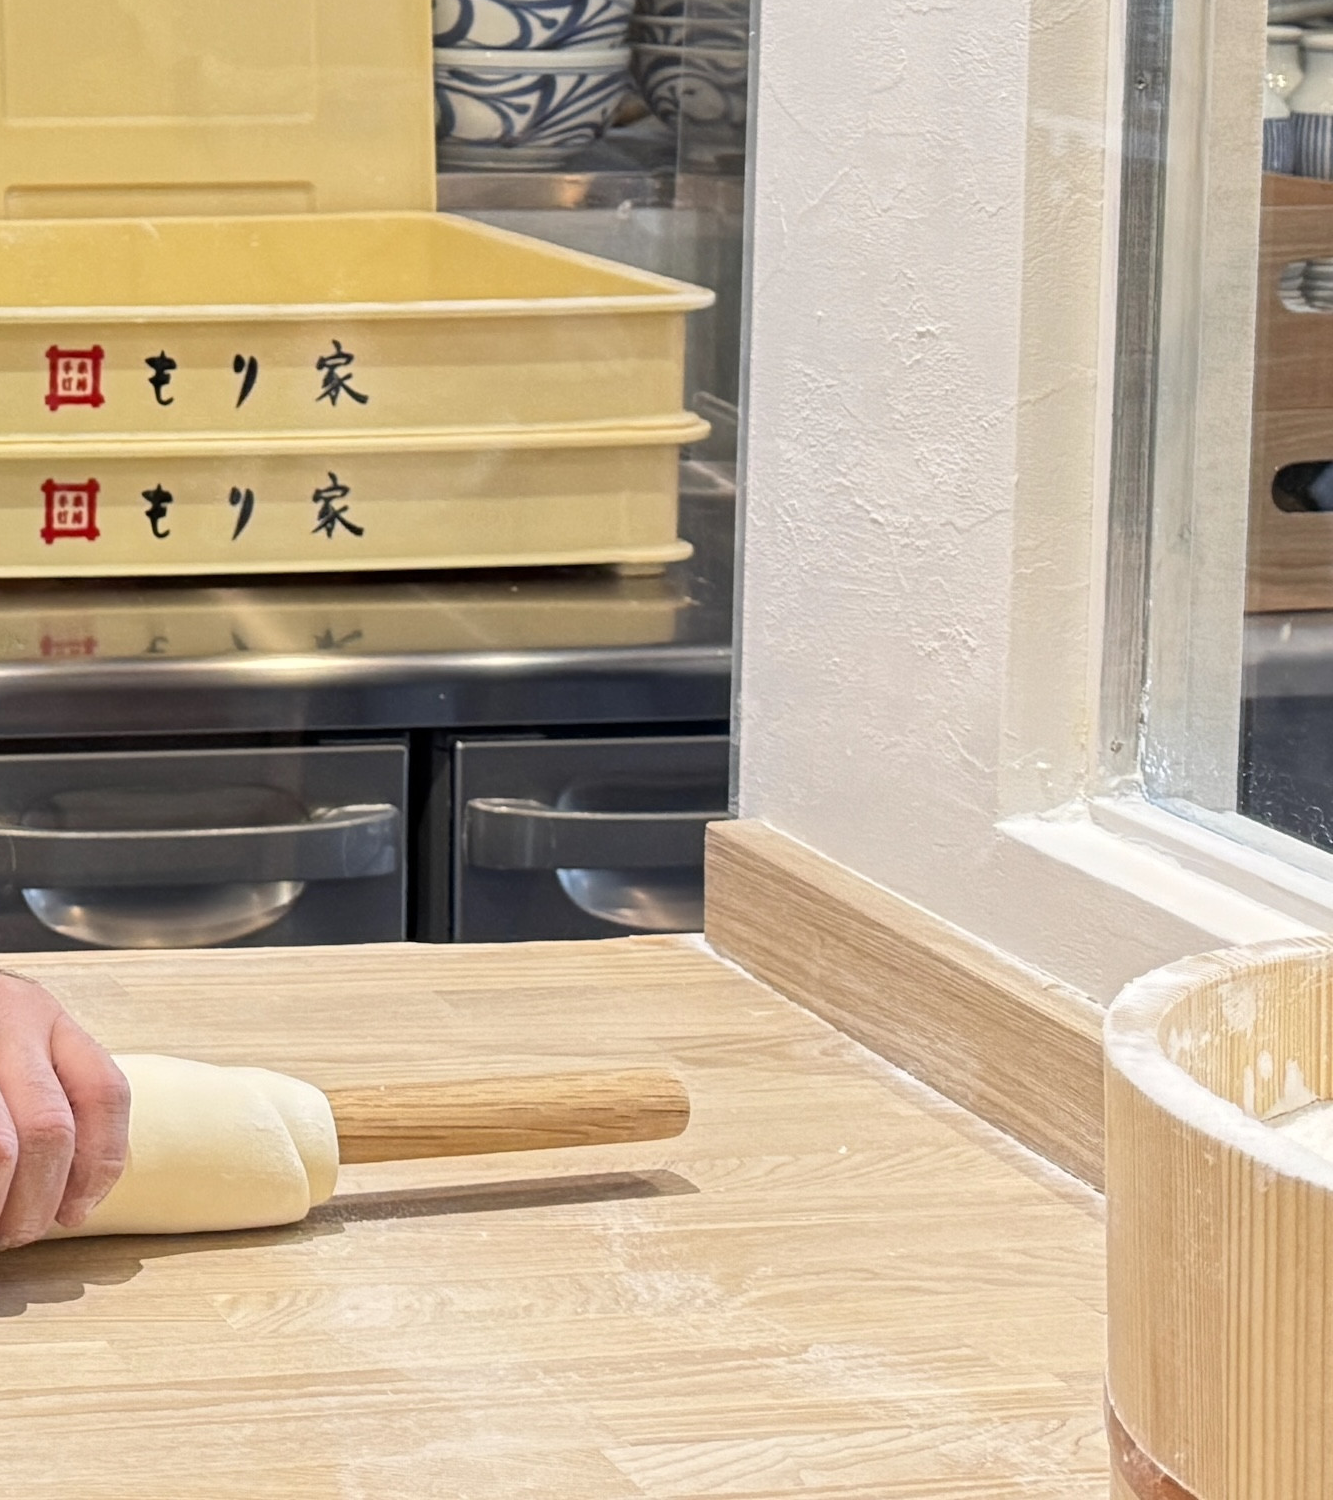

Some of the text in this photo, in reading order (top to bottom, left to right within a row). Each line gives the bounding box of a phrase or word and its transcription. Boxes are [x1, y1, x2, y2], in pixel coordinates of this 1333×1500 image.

[144, 339, 368, 408] もり家
[141, 471, 364, 540] もり家
